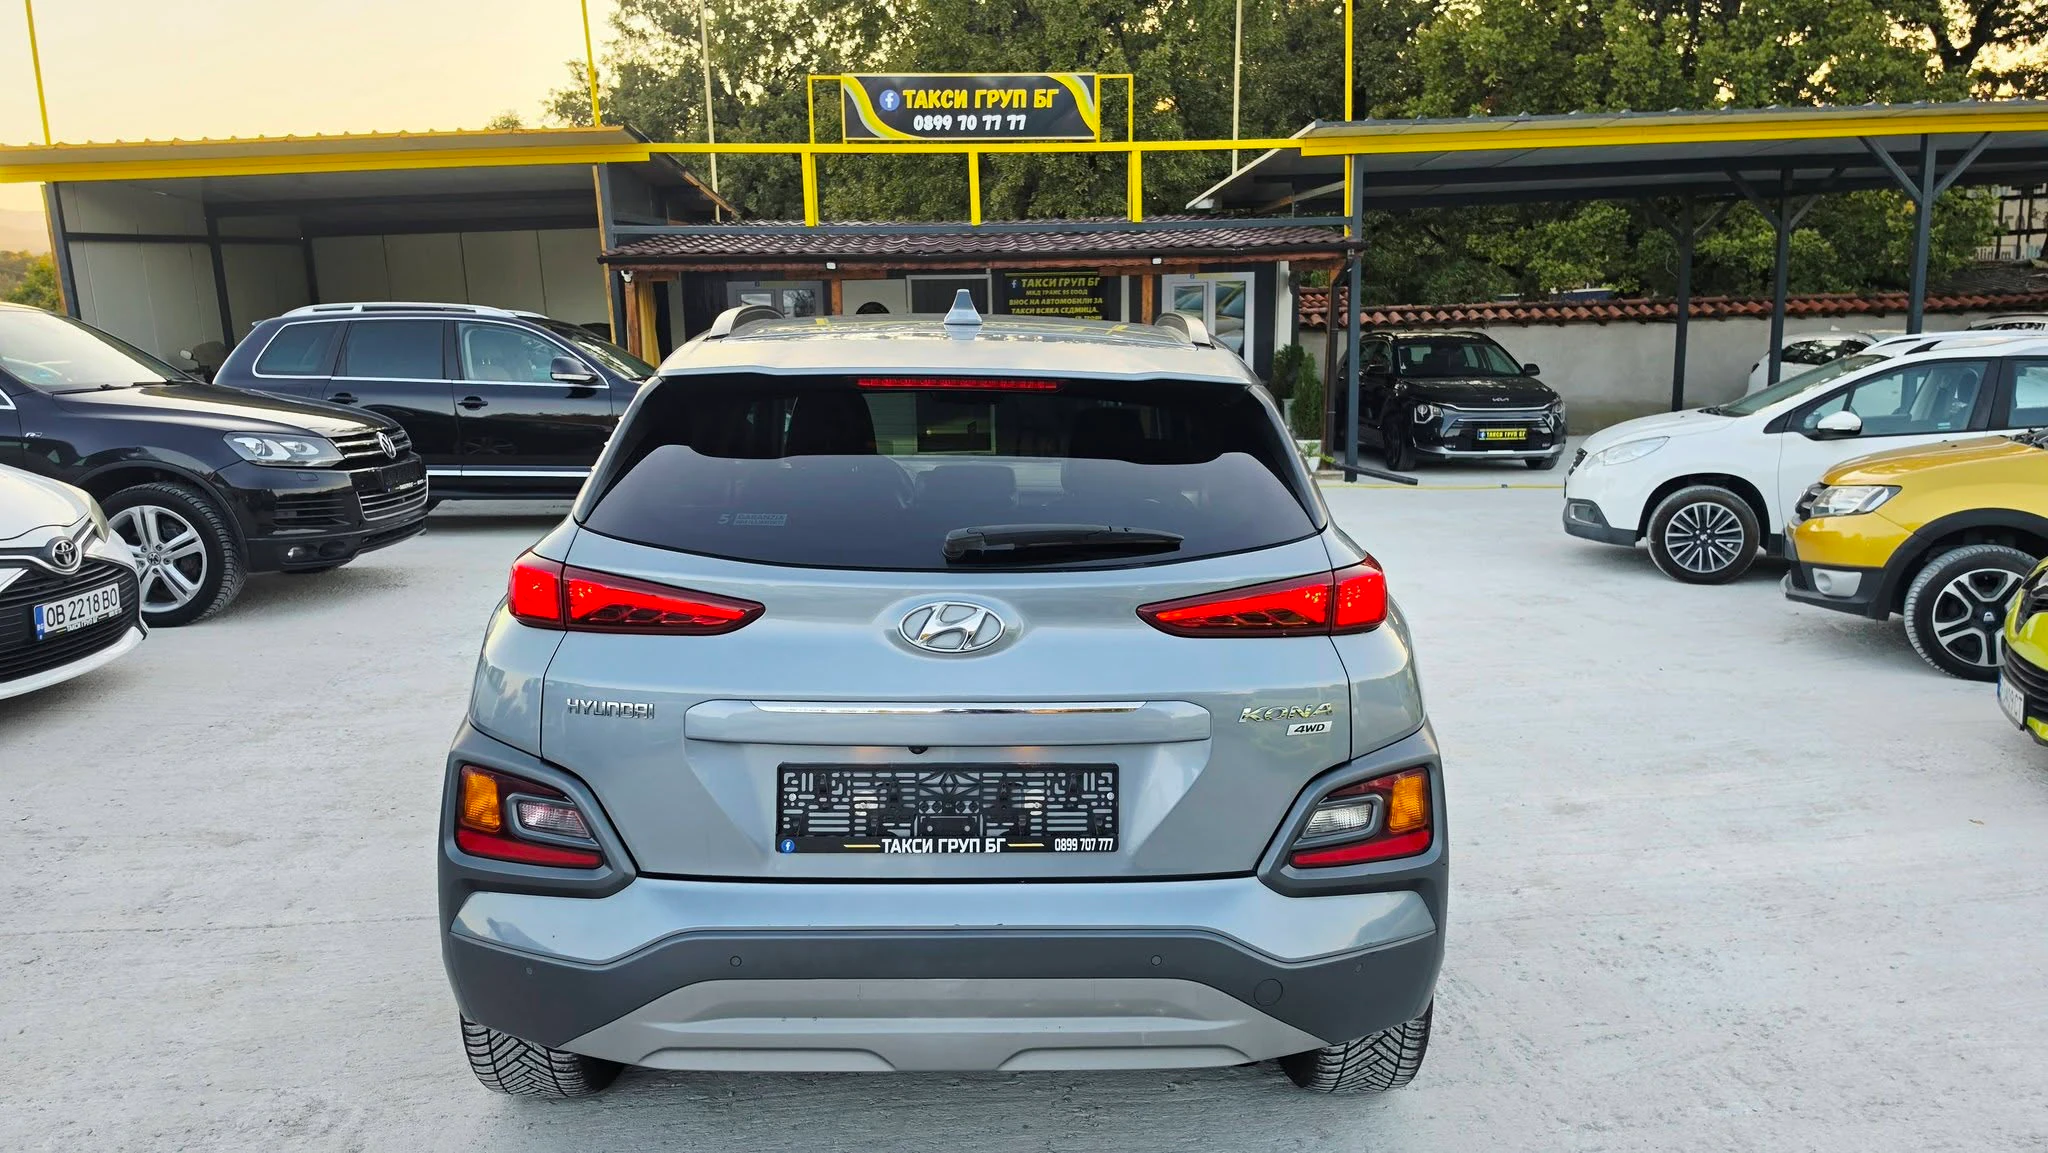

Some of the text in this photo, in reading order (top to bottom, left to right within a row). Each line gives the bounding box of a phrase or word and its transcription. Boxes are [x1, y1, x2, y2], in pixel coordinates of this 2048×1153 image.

[902, 88, 1060, 109] ТАКСИ ГРУП БГ
[913, 114, 1027, 131] 0899 70 77 77
[1020, 277, 1101, 288] ТАКСИ ГРУП БГ
[68, 593, 100, 621] 2218
[567, 698, 655, 719] HYUNDAI
[1238, 702, 1333, 723] KONA
[1293, 723, 1325, 733] 4WD
[881, 837, 1006, 853] ТАКСИ ГРУП БГ
[1054, 838, 1114, 851] 0899 707 777
